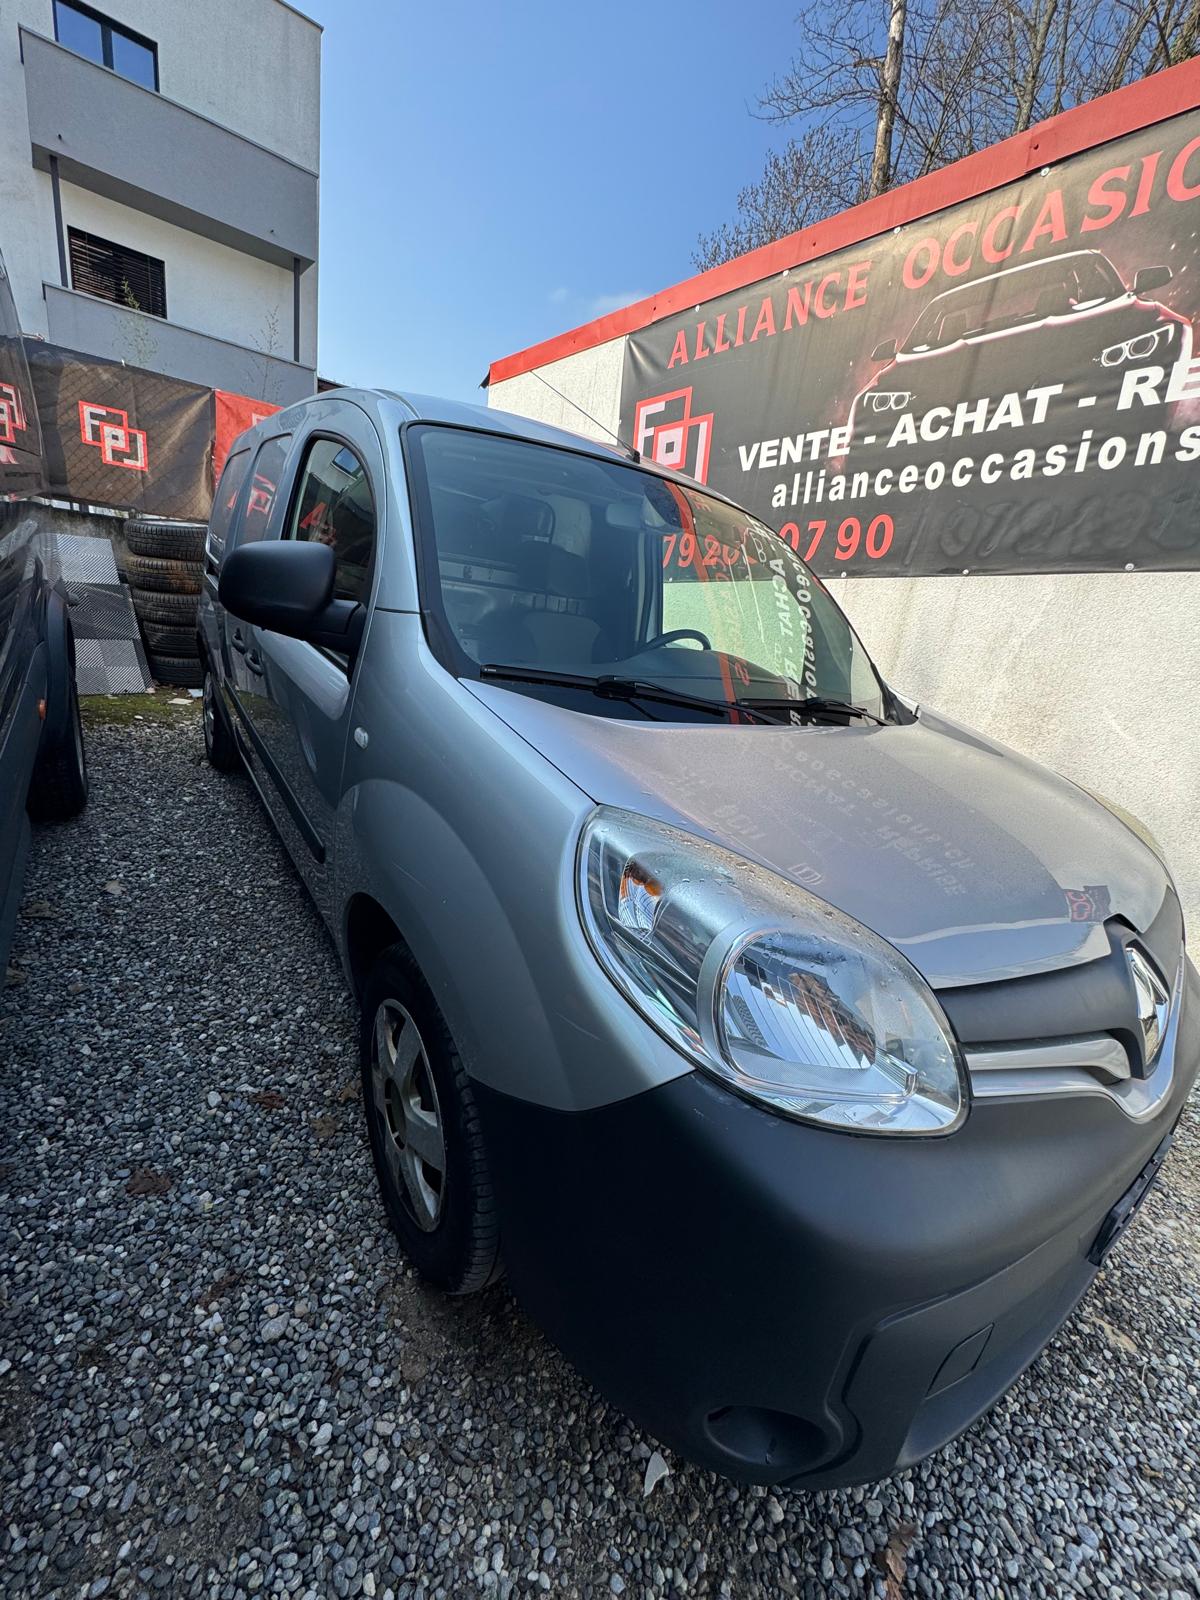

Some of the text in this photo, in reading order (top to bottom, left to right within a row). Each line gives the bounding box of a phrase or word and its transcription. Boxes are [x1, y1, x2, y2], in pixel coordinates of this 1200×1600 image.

[667, 260, 872, 369] ALLIANCE
[738, 425, 852, 472] VENTE
[886, 383, 1064, 449] ACHAT
[772, 425, 1200, 508] allianceoccasions
